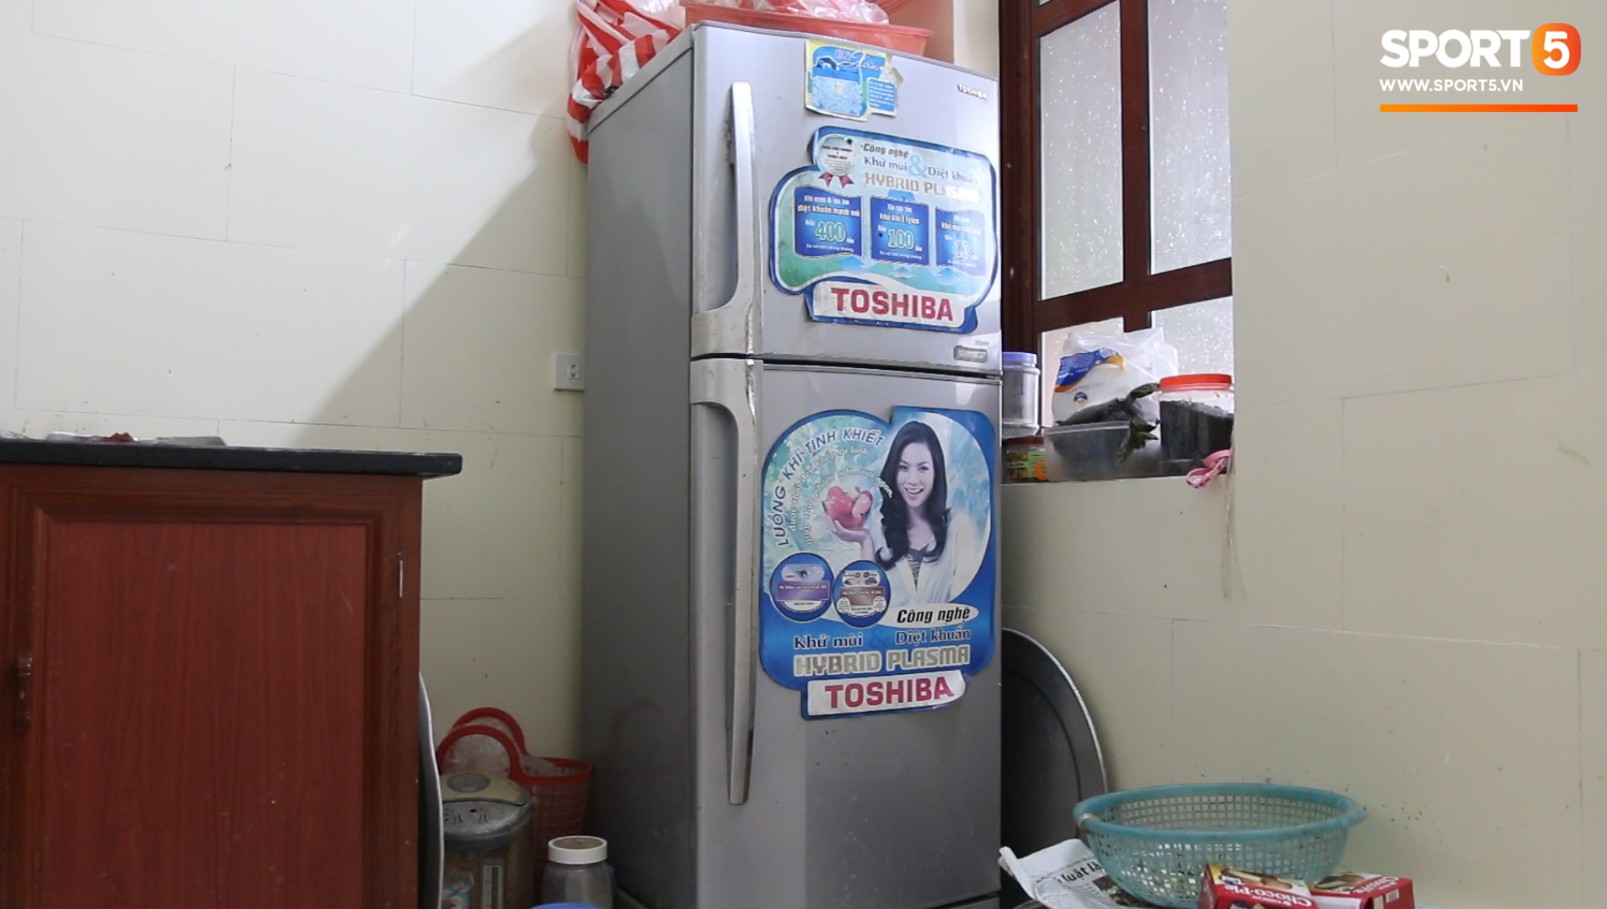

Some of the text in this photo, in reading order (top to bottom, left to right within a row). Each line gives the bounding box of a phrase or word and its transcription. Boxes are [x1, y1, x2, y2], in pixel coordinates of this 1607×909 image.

[864, 172, 920, 192] HYBRID
[815, 221, 848, 244] 400
[888, 229, 915, 251] 100
[831, 287, 953, 321] TOSHIBA
[843, 427, 885, 447] KHIẾT
[897, 607, 970, 624] Công nghệ
[832, 632, 864, 648] mùi
[895, 630, 926, 646] Diệt
[930, 625, 971, 642] khuẩn
[794, 645, 971, 677] HYBRID PLASMA
[824, 677, 955, 709] TOSHIBA
